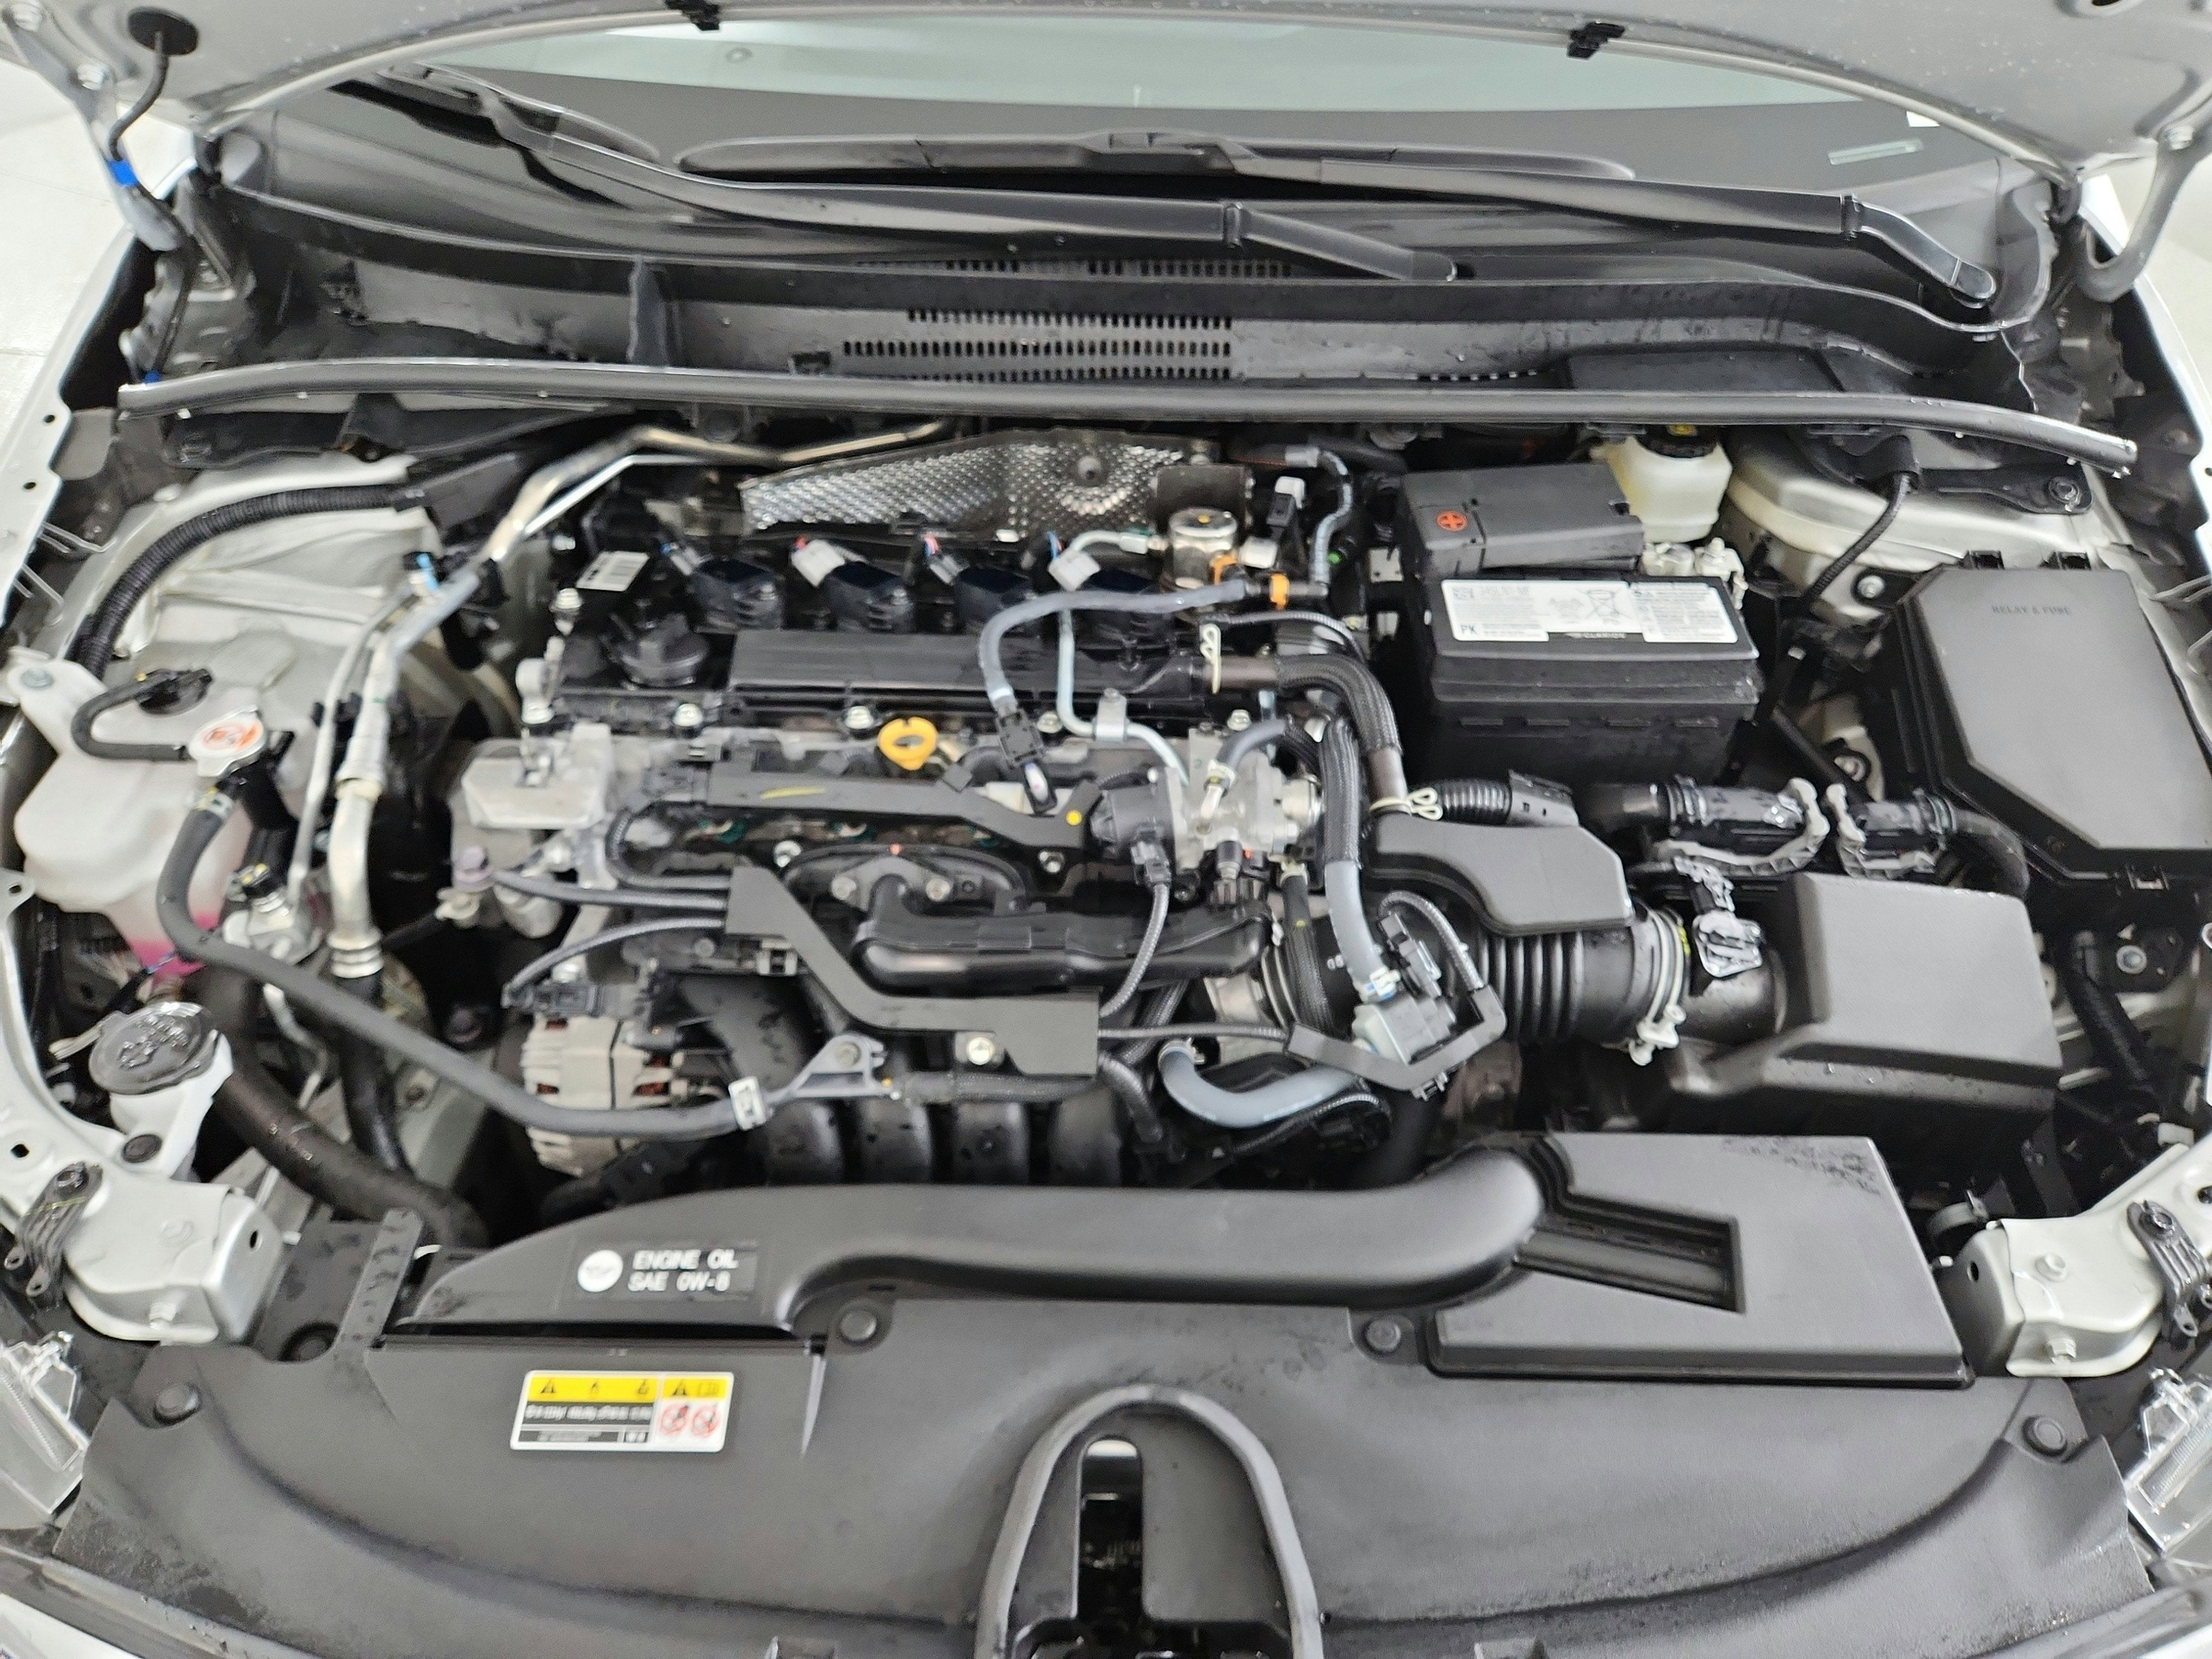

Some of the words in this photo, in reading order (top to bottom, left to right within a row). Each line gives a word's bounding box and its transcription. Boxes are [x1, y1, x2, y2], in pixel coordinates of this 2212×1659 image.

[1991, 606, 2027, 614] RELAY
[633, 1249, 701, 1270] ENGINE
[628, 1271, 669, 1292] SAE
